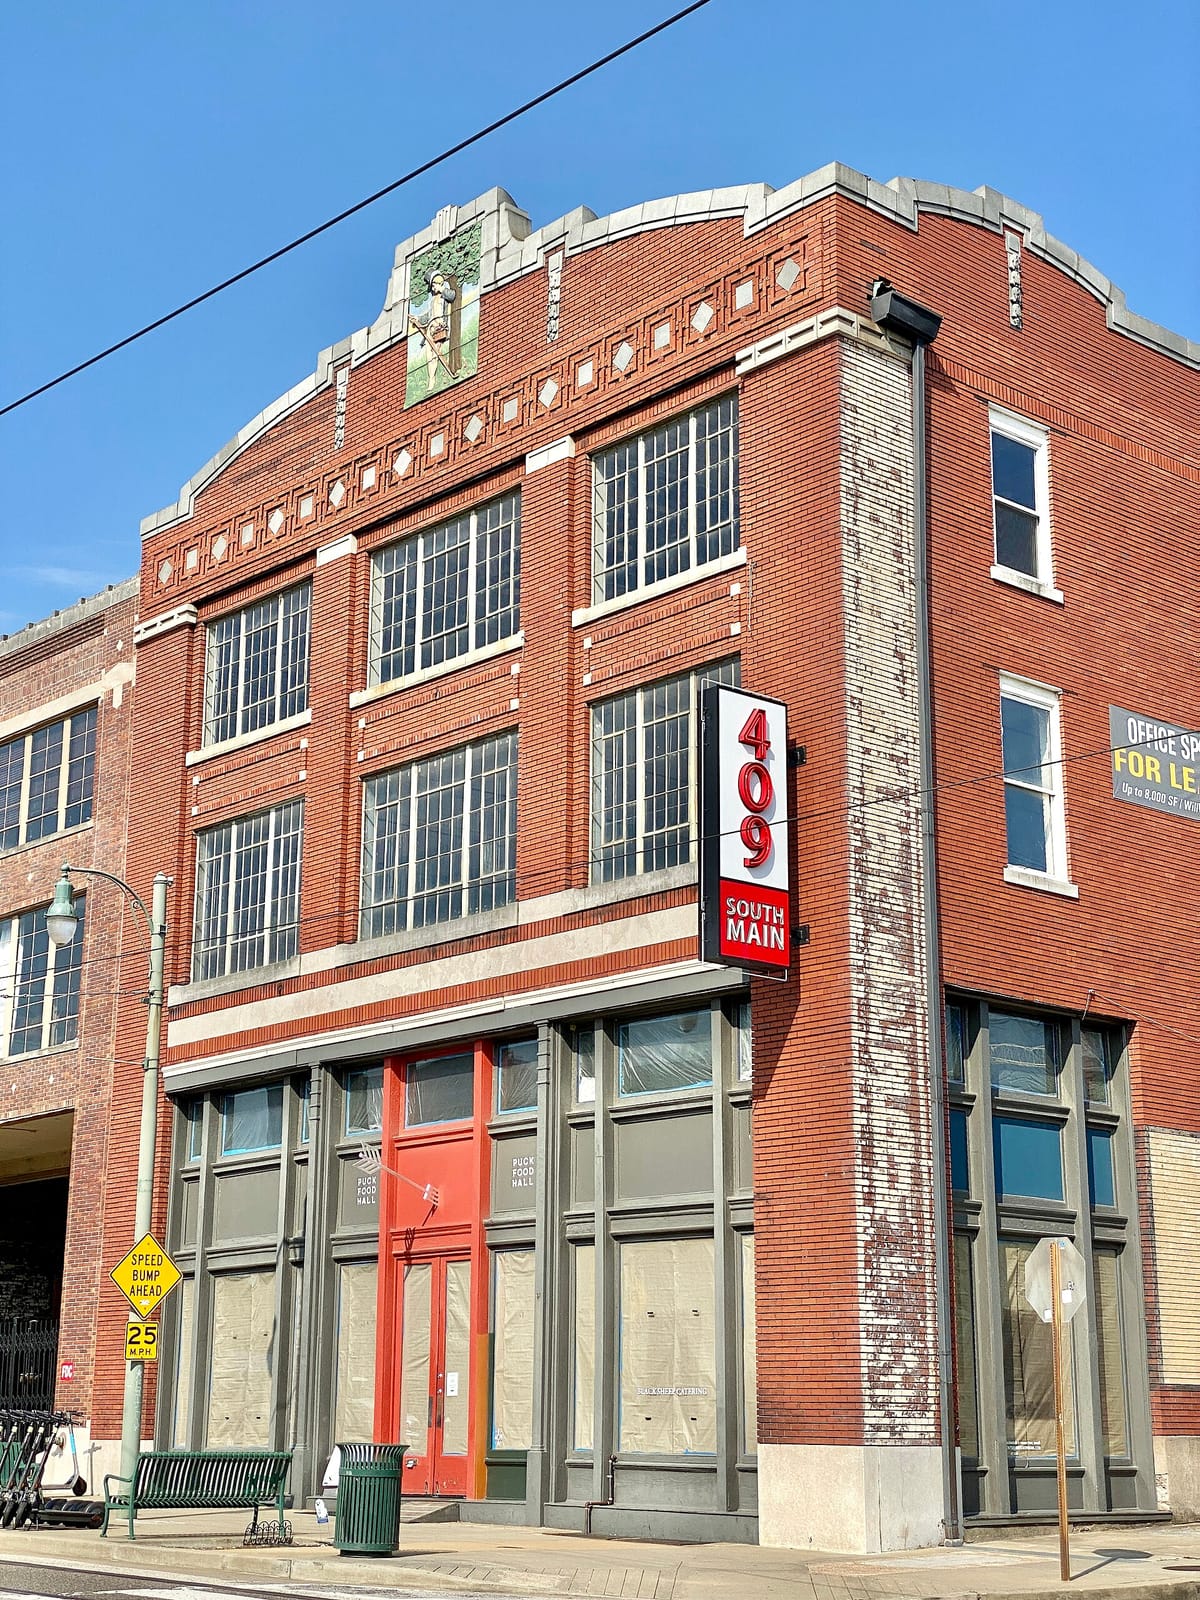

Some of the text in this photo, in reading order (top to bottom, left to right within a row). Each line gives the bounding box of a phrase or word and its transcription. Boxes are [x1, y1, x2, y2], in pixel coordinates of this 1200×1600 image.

[1127, 718, 1200, 761] OFFICE SP
[1114, 748, 1200, 794] FOR LE
[738, 708, 773, 868] 409
[1122, 782, 1133, 797] Up
[1134, 787, 1142, 797] to
[1144, 788, 1166, 803] 8,000
[1167, 795, 1178, 807] SF
[726, 897, 784, 926] SOUTH
[726, 917, 785, 951] MAIN
[512, 1156, 535, 1167] PUCK
[512, 1167, 535, 1177] FOOD
[357, 1176, 377, 1186] PUCK
[511, 1178, 534, 1188] HALL
[357, 1186, 377, 1196] FOOD
[357, 1196, 376, 1205] HALL
[131, 1253, 163, 1266] SPEED
[132, 1269, 160, 1282] BUMP
[129, 1284, 162, 1297] AHEAD
[128, 1326, 157, 1345] 25
[676, 1387, 708, 1397] CATERING
